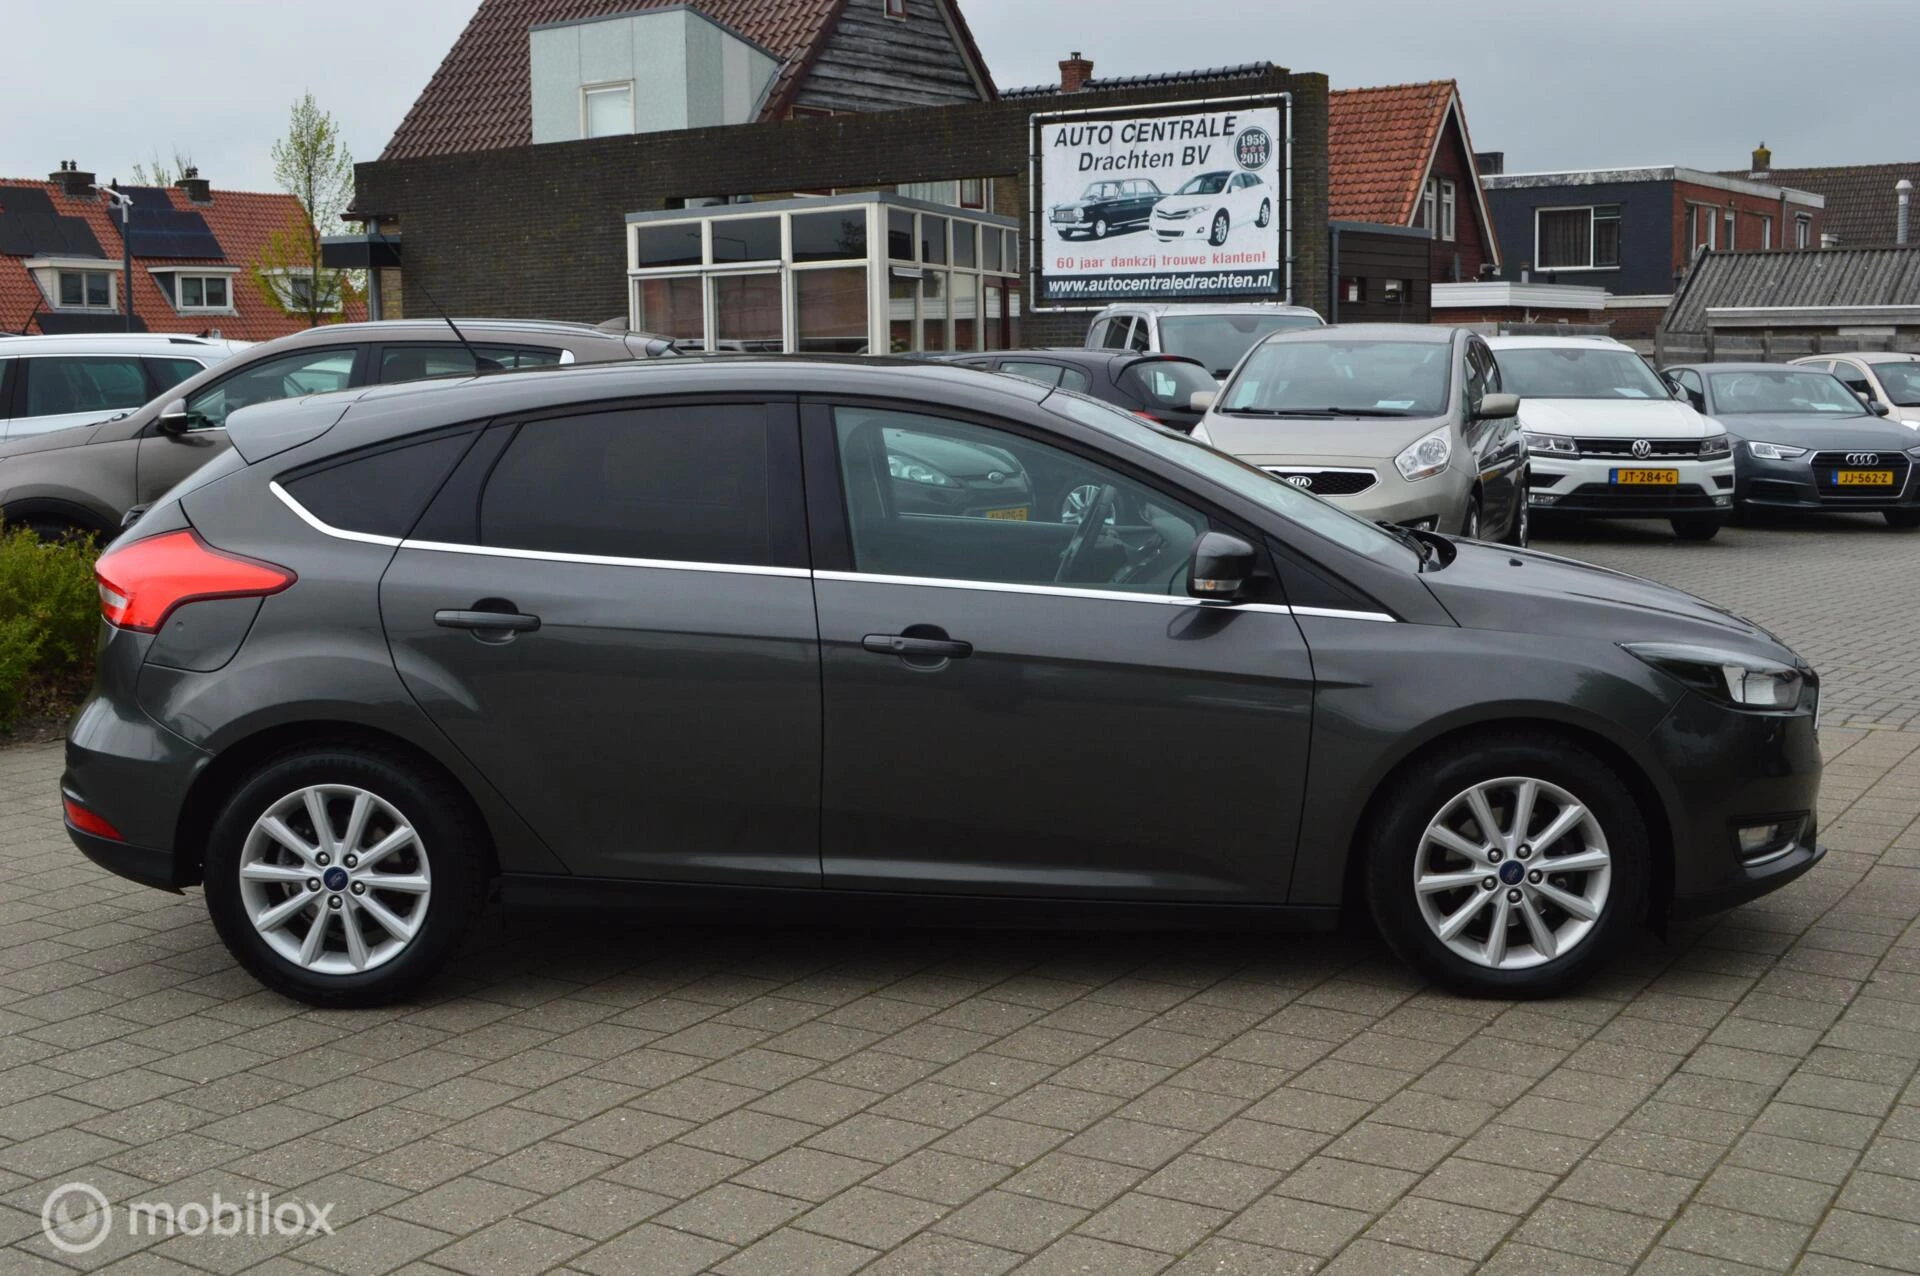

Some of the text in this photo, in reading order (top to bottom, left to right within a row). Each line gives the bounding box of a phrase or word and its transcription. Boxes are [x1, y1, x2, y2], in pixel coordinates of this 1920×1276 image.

[1054, 116, 1237, 147] AUTO CENTRALE
[1241, 133, 1266, 146] 1958
[1079, 145, 1211, 171] Drachten BV
[1240, 151, 1266, 164] 2018
[1056, 250, 1266, 270] 60 jaar dankzij trouwe klanten!
[1048, 271, 1274, 292] www.autocentraledrachten.nl
[1289, 477, 1308, 486] KIA
[1622, 471, 1673, 482] JT-284-G
[1841, 473, 1888, 483] JJ-562-Z
